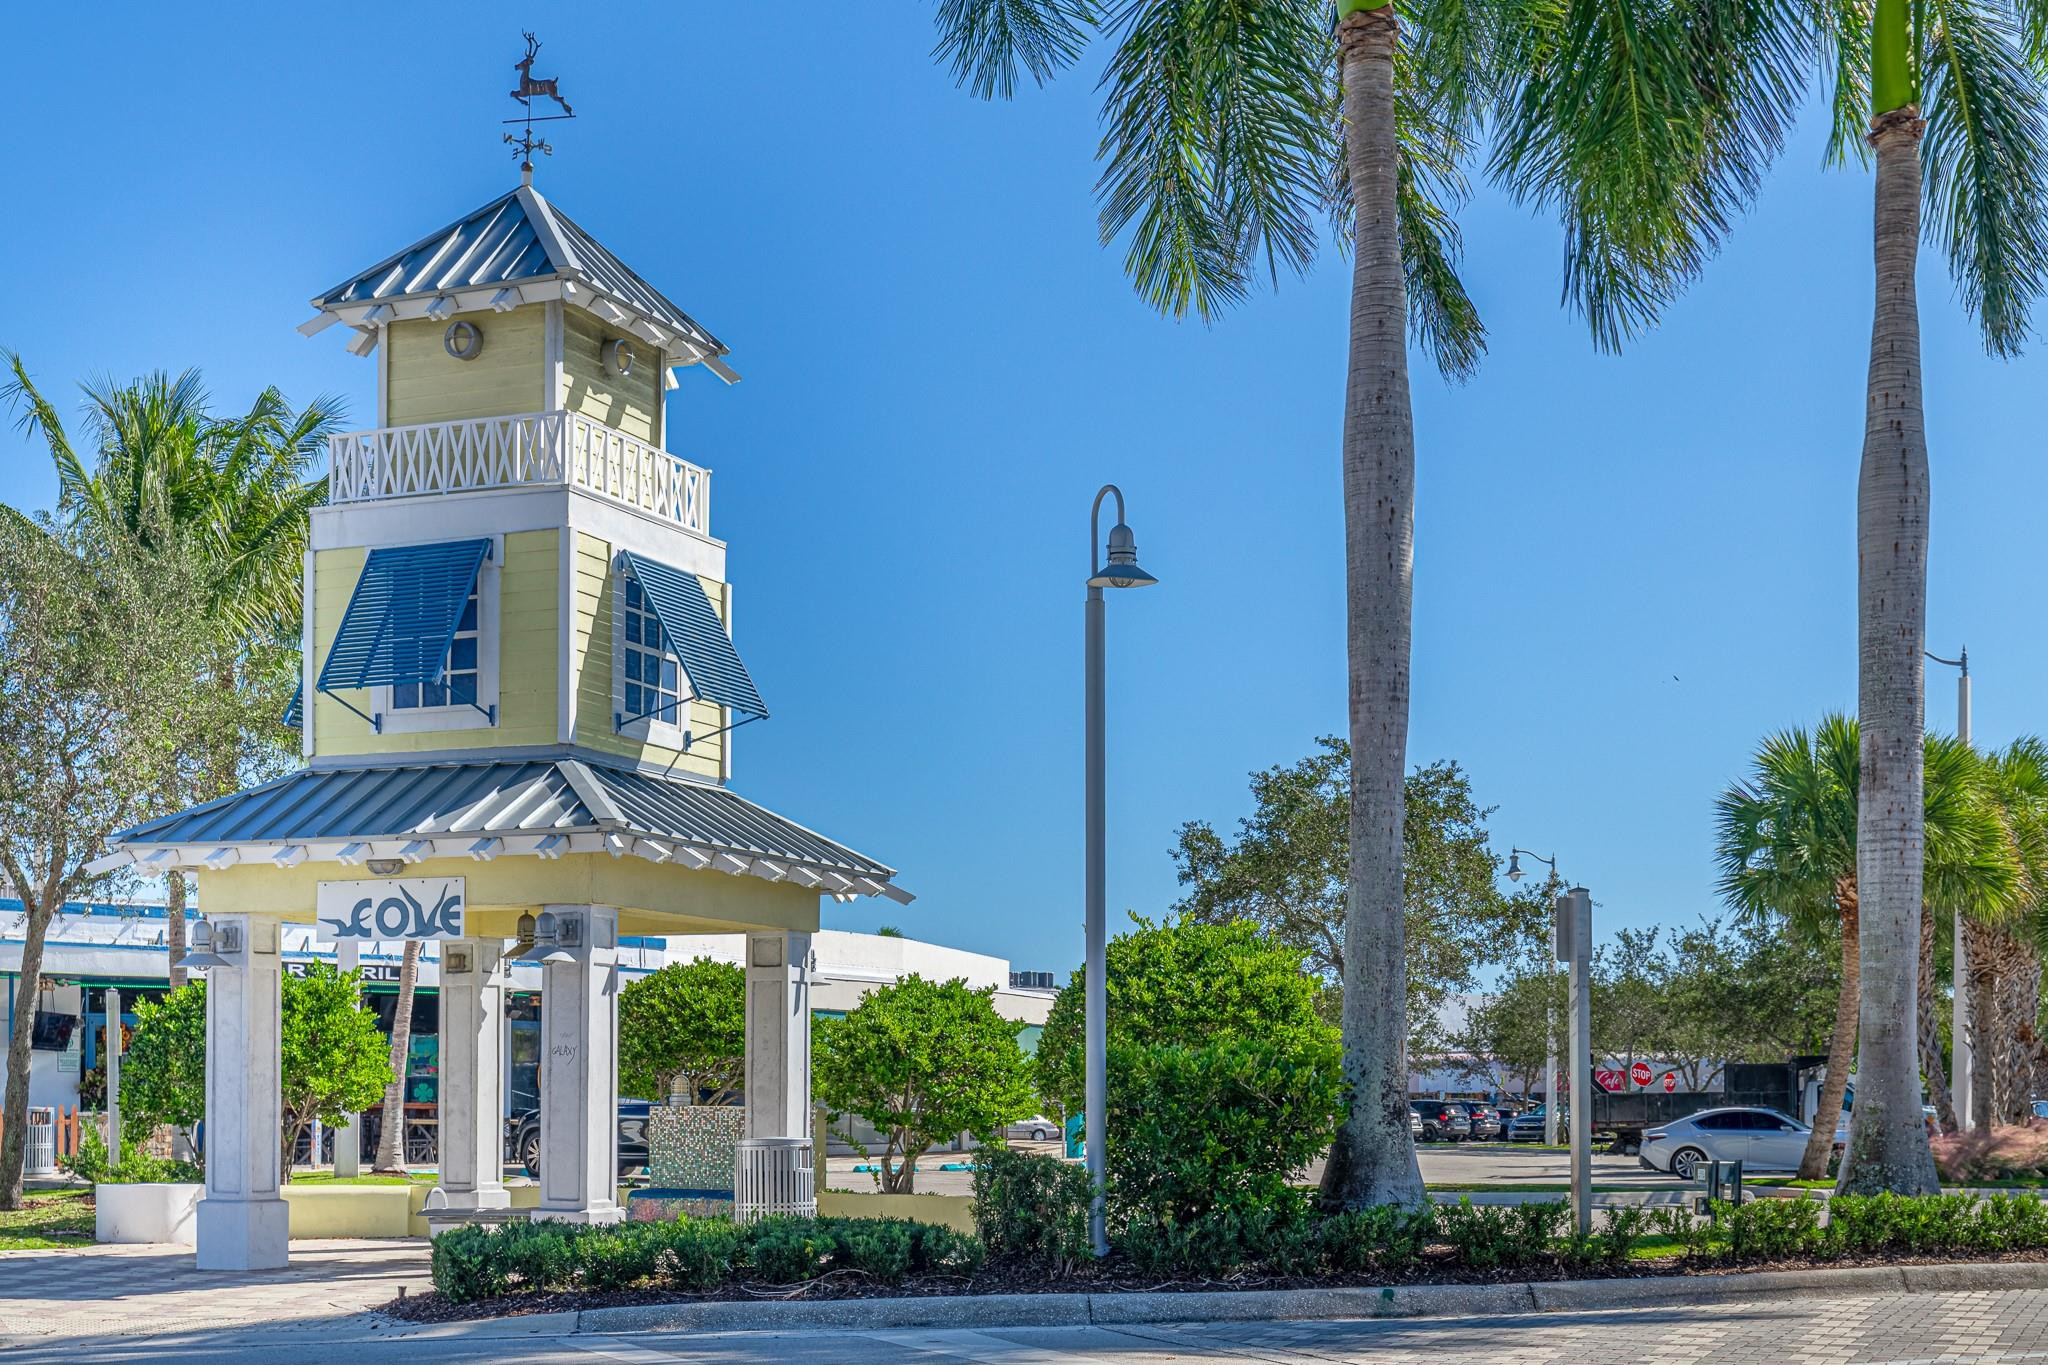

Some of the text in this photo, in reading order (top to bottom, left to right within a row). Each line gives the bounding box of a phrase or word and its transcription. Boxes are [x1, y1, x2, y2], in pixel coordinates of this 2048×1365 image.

[318, 883, 461, 938] COVE
[551, 1044, 578, 1065] GALAXY
[1632, 1068, 1651, 1080] STOP
